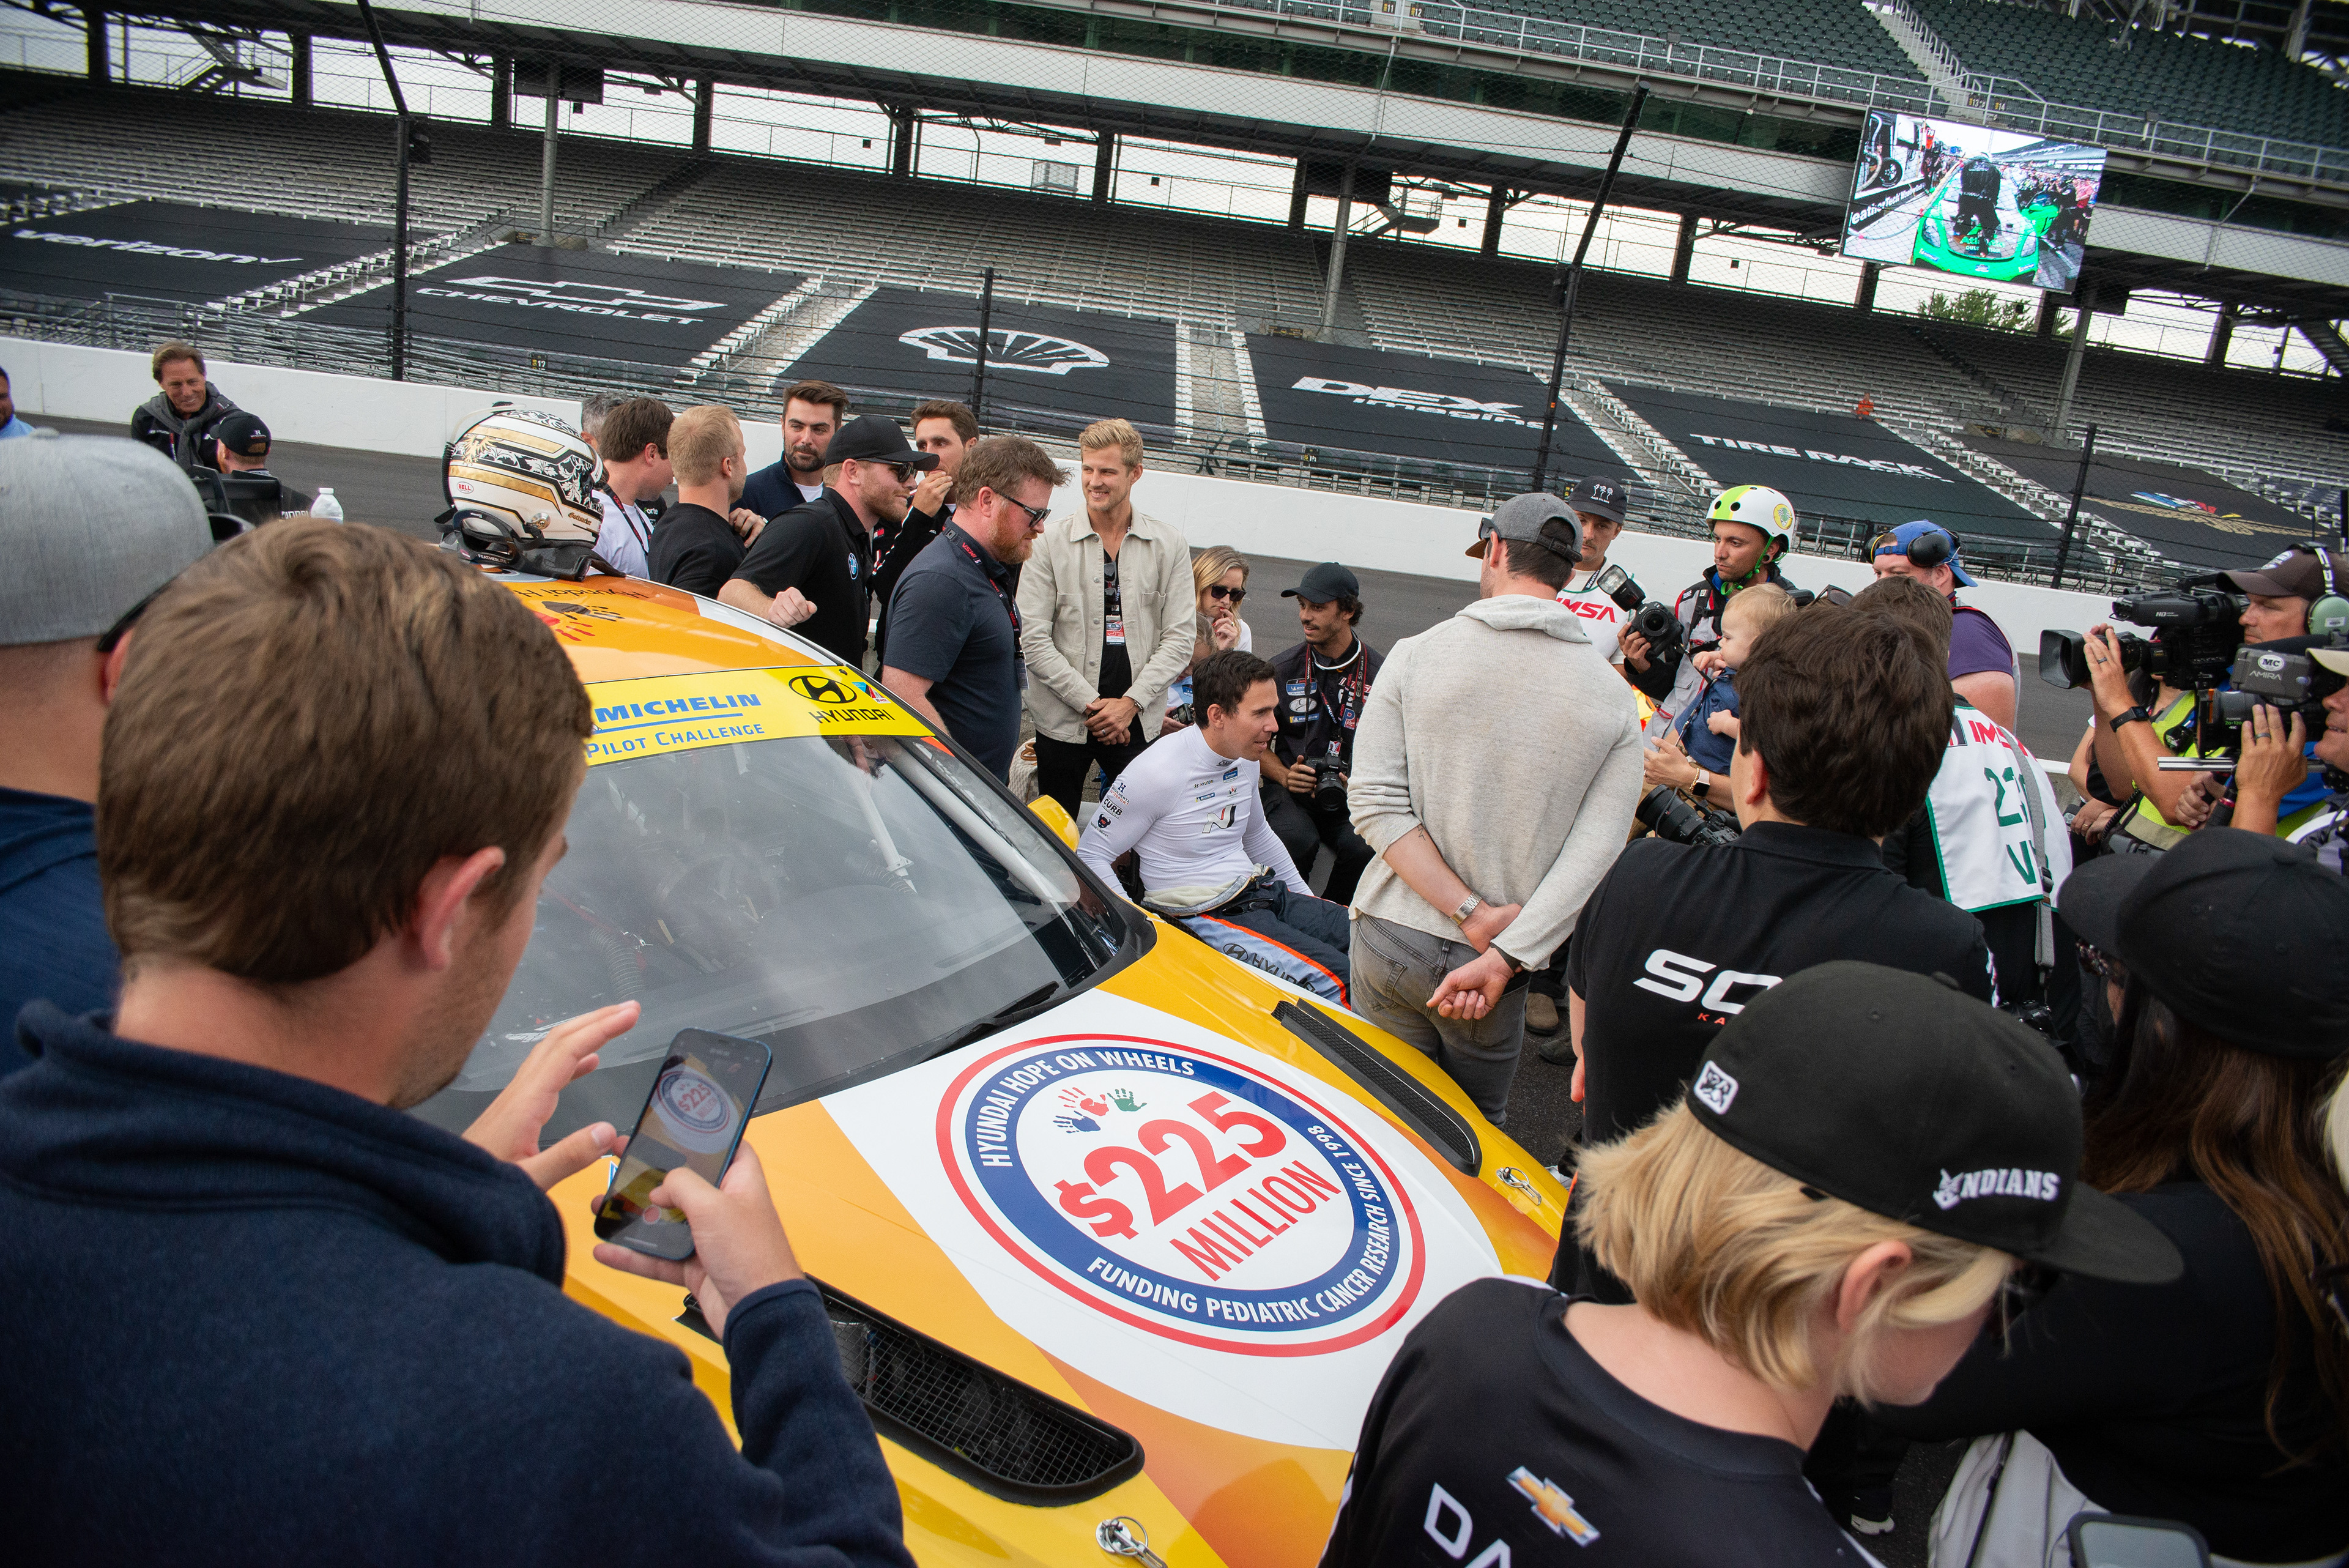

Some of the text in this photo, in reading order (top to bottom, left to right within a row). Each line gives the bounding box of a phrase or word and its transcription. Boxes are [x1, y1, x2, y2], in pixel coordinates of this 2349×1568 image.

[13, 229, 259, 264] verizon
[416, 288, 704, 325] CHEVROLET
[1291, 376, 1523, 414] DEX
[1690, 433, 1943, 479] TIRE RACK
[962, 541, 976, 559] IMSA
[1358, 671, 1364, 680] 5D
[2249, 671, 2282, 681] AMIRA
[2262, 658, 2280, 667] MC
[595, 693, 762, 724] MICHELIN
[807, 708, 896, 724] HYUNDAI
[586, 722, 766, 759] PILOT CHALLENGE
[1104, 798, 1123, 816] CURB
[976, 1050, 1196, 1167] HYUNDAI HOPE ON WHEELS
[1053, 1090, 1287, 1240] $225
[1086, 1123, 1387, 1325] FUNDING PEDIATRIC CANCER RESEARCH SINCE 1998
[1169, 1159, 1342, 1282] MILLION
